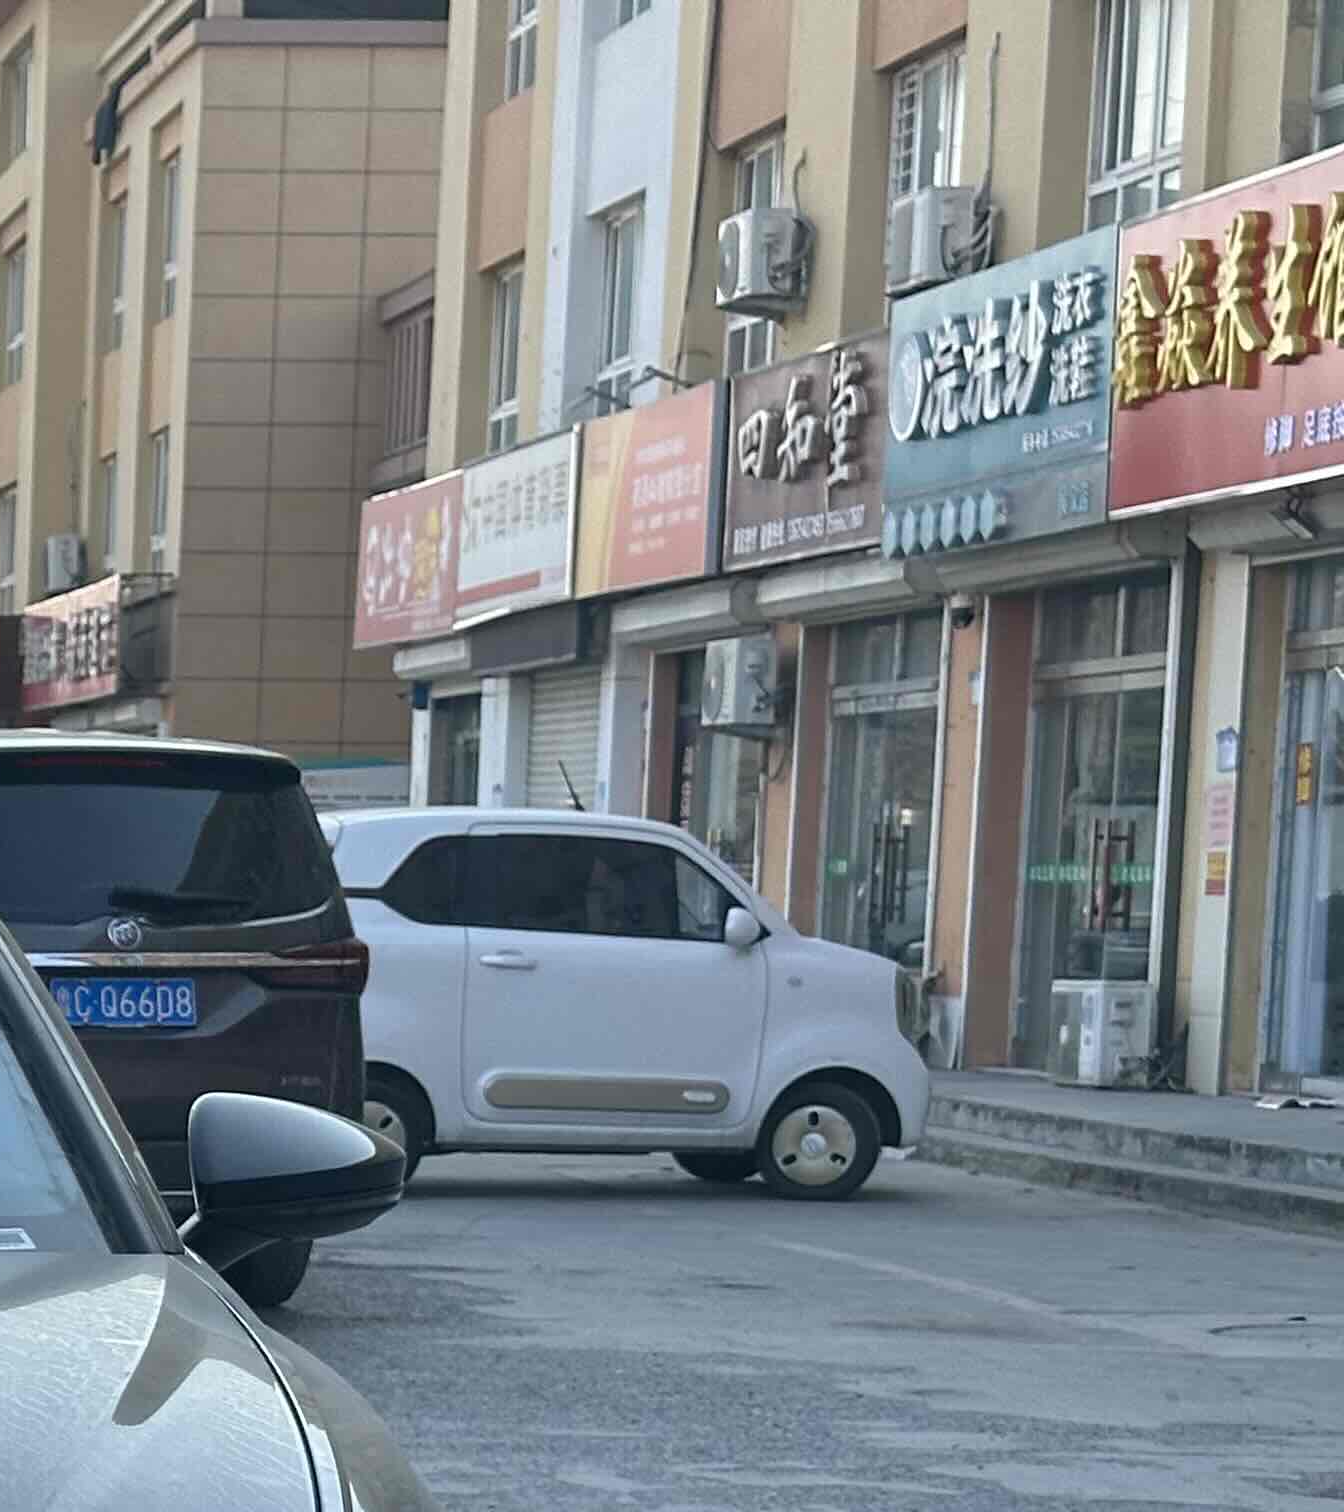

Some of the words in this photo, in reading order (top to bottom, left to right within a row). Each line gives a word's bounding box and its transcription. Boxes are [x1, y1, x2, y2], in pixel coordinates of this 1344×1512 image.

[1052, 267, 1105, 336] 洗衣
[1049, 336, 1097, 406] 洗鞋
[738, 351, 867, 487] 四和堂
